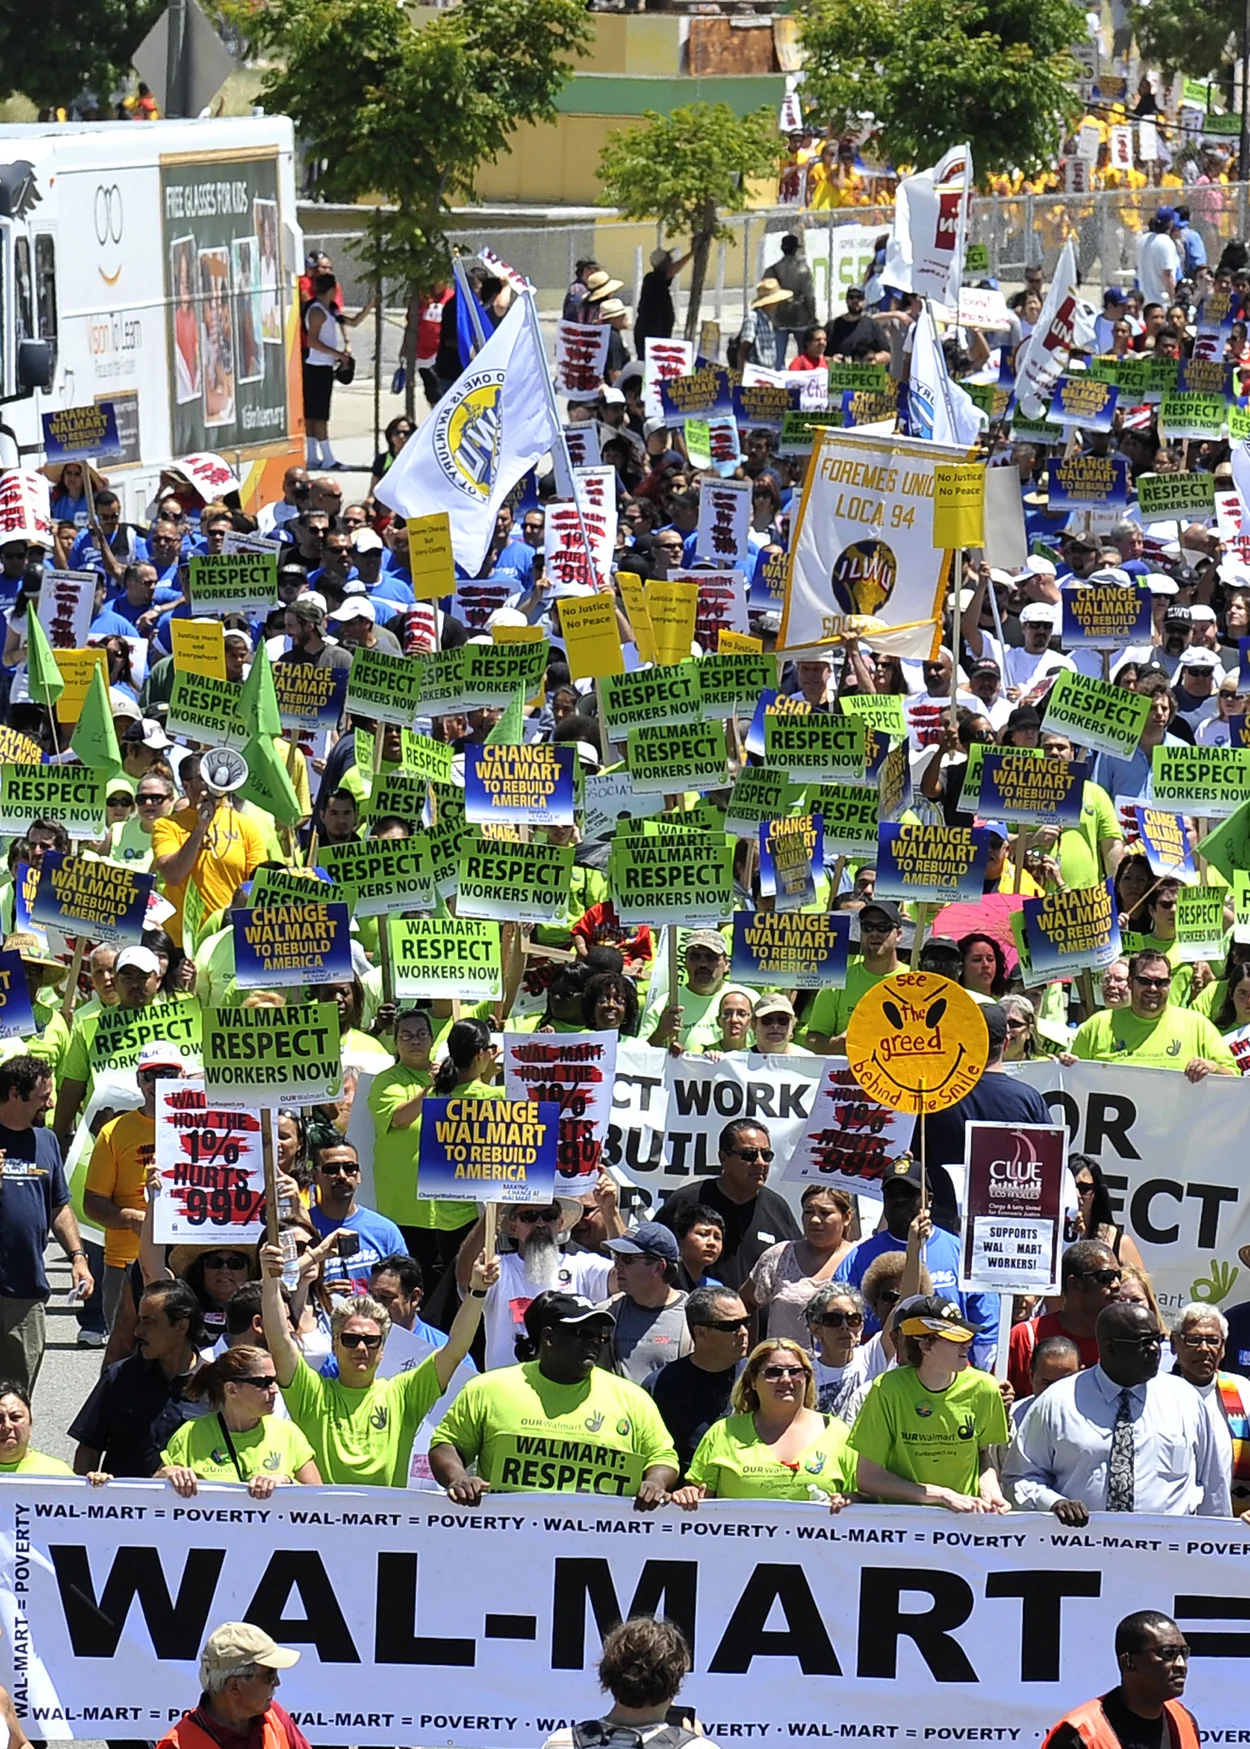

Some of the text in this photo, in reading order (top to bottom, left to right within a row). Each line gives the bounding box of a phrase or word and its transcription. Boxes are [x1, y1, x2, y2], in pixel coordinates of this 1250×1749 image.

[166, 182, 248, 218] FREE GLASSES FOR KIDS
[830, 371, 882, 388] RESPECT
[52, 407, 102, 420] CHANGE
[49, 416, 108, 434] WALMART
[938, 473, 982, 481] No Justice
[1142, 473, 1203, 487] WALMART:
[1142, 484, 1209, 501] RESPECT
[1140, 499, 1214, 514] WORKERS NOW
[891, 505, 916, 529] 94
[200, 555, 266, 567] WALMART:
[196, 567, 271, 584] RESPECT
[839, 557, 892, 593] ILWU
[192, 585, 275, 599] WORKERS NOW
[177, 632, 218, 642] Justice Here
[178, 652, 218, 661] Everywhere
[362, 650, 414, 673] WALMART:
[354, 665, 416, 693] RESPECT
[349, 686, 416, 711] WORKERS NOW
[1070, 673, 1140, 707] WALMART:
[1058, 689, 1141, 727] RESPECT
[776, 716, 851, 728] WALMART:
[1048, 708, 1138, 745] WORKERS NOW
[771, 730, 858, 749] RESPECT
[766, 753, 863, 767] WORKERS NOW
[899, 825, 971, 845] CHANGE
[890, 840, 977, 861] WALMART
[896, 859, 968, 875] TO REBUILD
[902, 874, 958, 888] AMERICA
[252, 904, 327, 924] CHANGE
[245, 921, 337, 944] WALMART
[406, 920, 486, 936] WALMART:
[254, 939, 330, 957] TO REBUILD
[402, 939, 492, 961] RESPECT
[263, 955, 322, 971] AMERICA
[397, 965, 499, 980] WORKERS NOW
[896, 973, 927, 988] see
[217, 1006, 318, 1027] WALMART:
[901, 1004, 925, 1022] the
[211, 1029, 328, 1059] RESPECT
[880, 1026, 943, 1062] greed
[206, 1061, 339, 1084] WORKERS NOW
[852, 1060, 901, 1106] behind
[674, 1080, 811, 1119] WORK
[446, 1100, 538, 1123] CHANGE
[436, 1121, 546, 1146] WALMART
[444, 1144, 537, 1164] TO REBUILD
[454, 1163, 527, 1181] AMERICA
[990, 1160, 1043, 1181] CLUE
[989, 1190, 1040, 1199] LOS ANGELES
[990, 1227, 1037, 1239] SUPPORTS
[983, 1242, 1042, 1254] WAL MART
[988, 1258, 1036, 1270] WORKERS!
[35, 1504, 147, 1519] WAL-MART
[173, 1508, 271, 1523] POVERTY
[290, 1511, 402, 1527] WAL-MART
[427, 1515, 525, 1531] POVERTY
[543, 1518, 655, 1535] WAL-MART
[680, 1522, 779, 1539] POVERTY
[797, 1526, 907, 1544] WAL-MART
[932, 1531, 1026, 1548] POVERTY
[1051, 1535, 1162, 1552] WAL-MART
[15, 1504, 31, 1592] POVERTY
[47, 1545, 1102, 1683] WAL-MART
[14, 1617, 29, 1719] WAL-MART
[32, 1707, 142, 1721] WAL-MART
[420, 1715, 517, 1730] POVERTY
